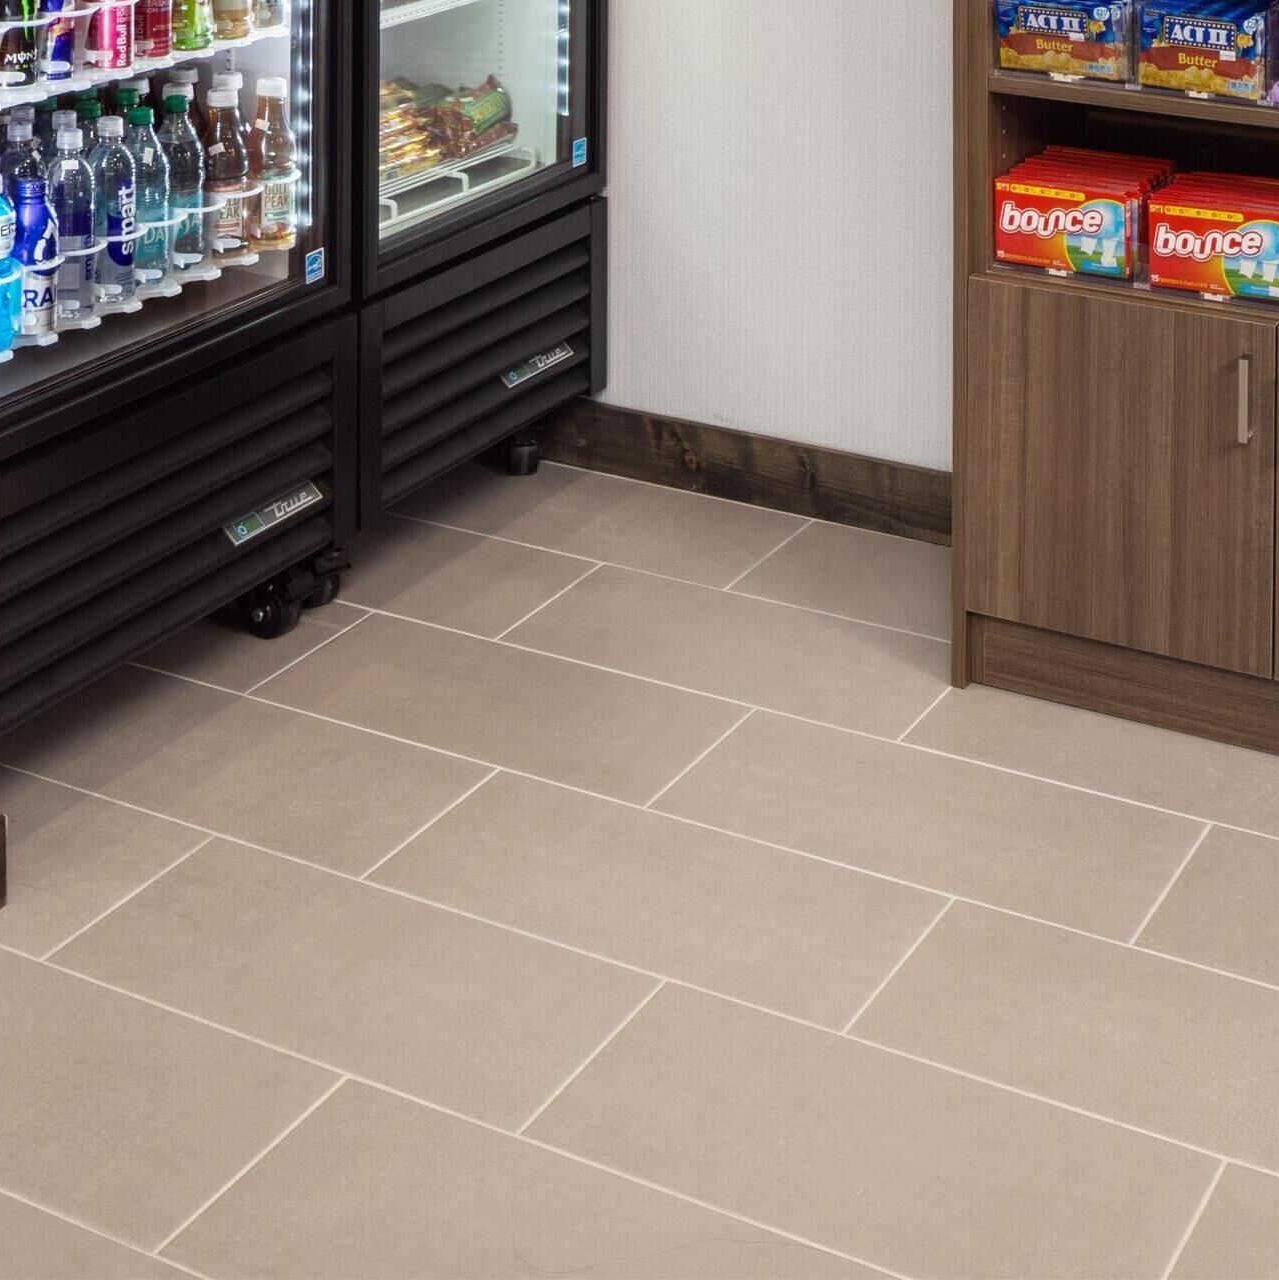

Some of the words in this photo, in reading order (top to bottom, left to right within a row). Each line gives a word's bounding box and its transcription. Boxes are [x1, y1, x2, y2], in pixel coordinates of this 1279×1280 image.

[1025, 13, 1057, 31] ACT
[117, 24, 127, 45] Bull
[1171, 24, 1204, 43] ACT
[1036, 38, 1074, 51] Butter
[117, 46, 127, 66] Red
[1178, 52, 1217, 68] Butter
[263, 195, 290, 208] PEAK
[119, 183, 136, 256] smart
[999, 200, 1105, 239] bounce
[1153, 223, 1263, 262] bounce
